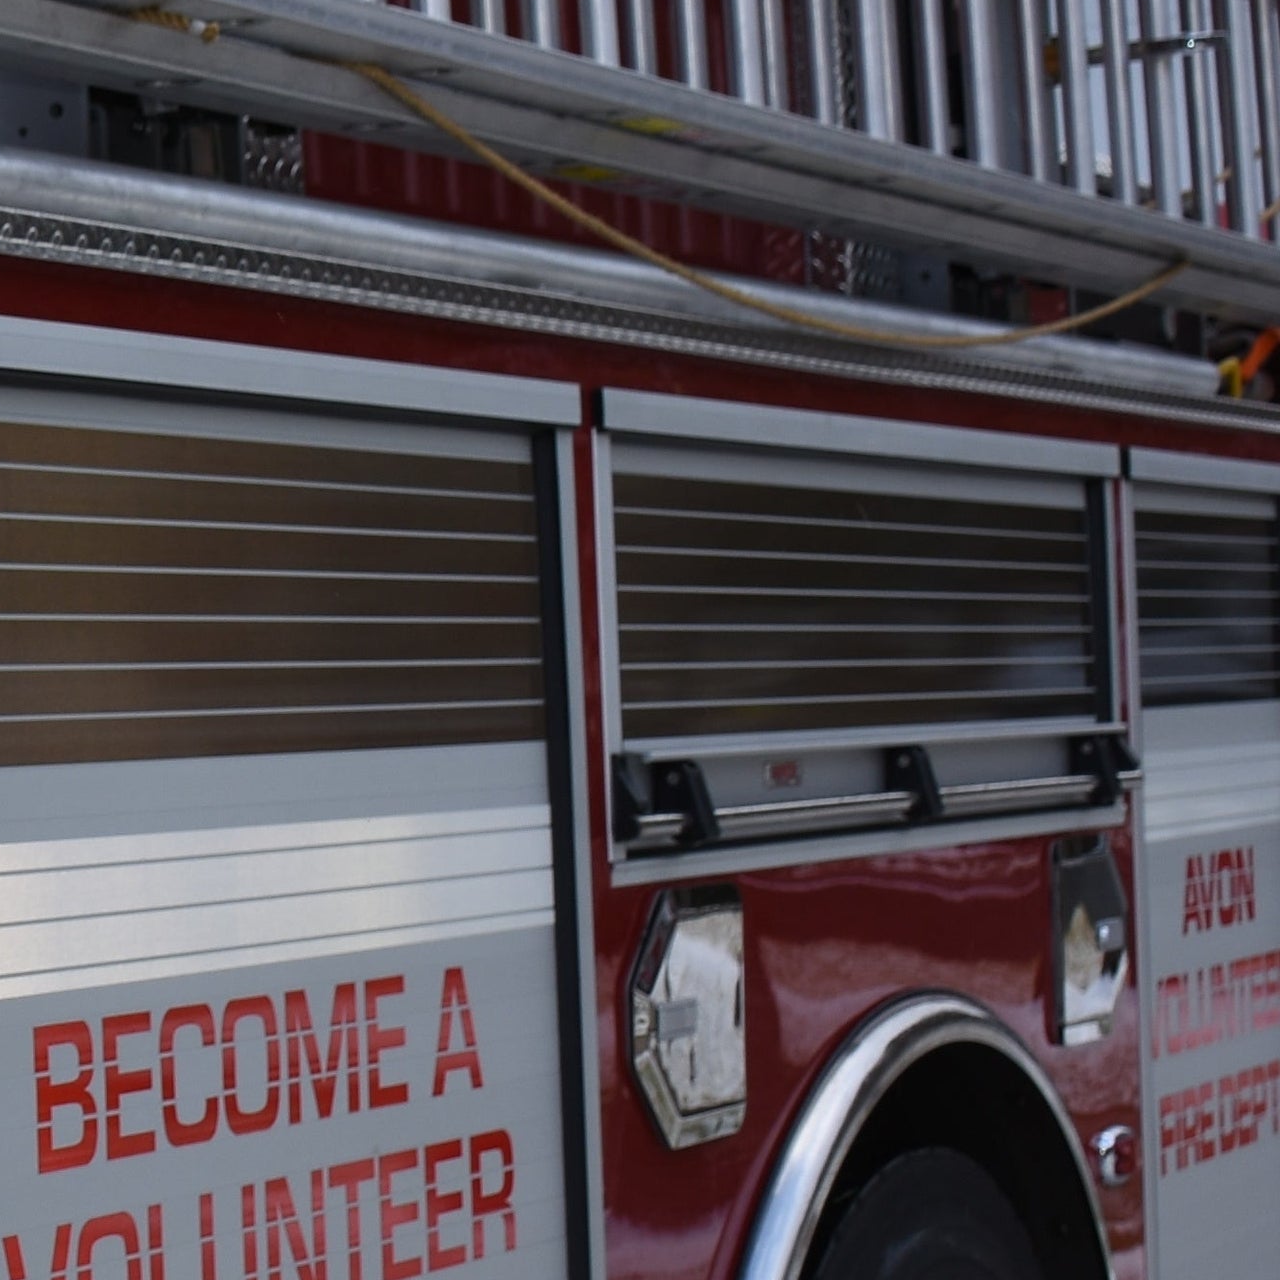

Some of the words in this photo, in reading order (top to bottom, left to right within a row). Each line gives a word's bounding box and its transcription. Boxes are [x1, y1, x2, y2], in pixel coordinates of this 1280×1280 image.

[1182, 845, 1256, 937] AVON
[32, 974, 410, 1175] BECOME
[431, 966, 483, 1098] A
[1158, 1080, 1216, 1178] FIRE
